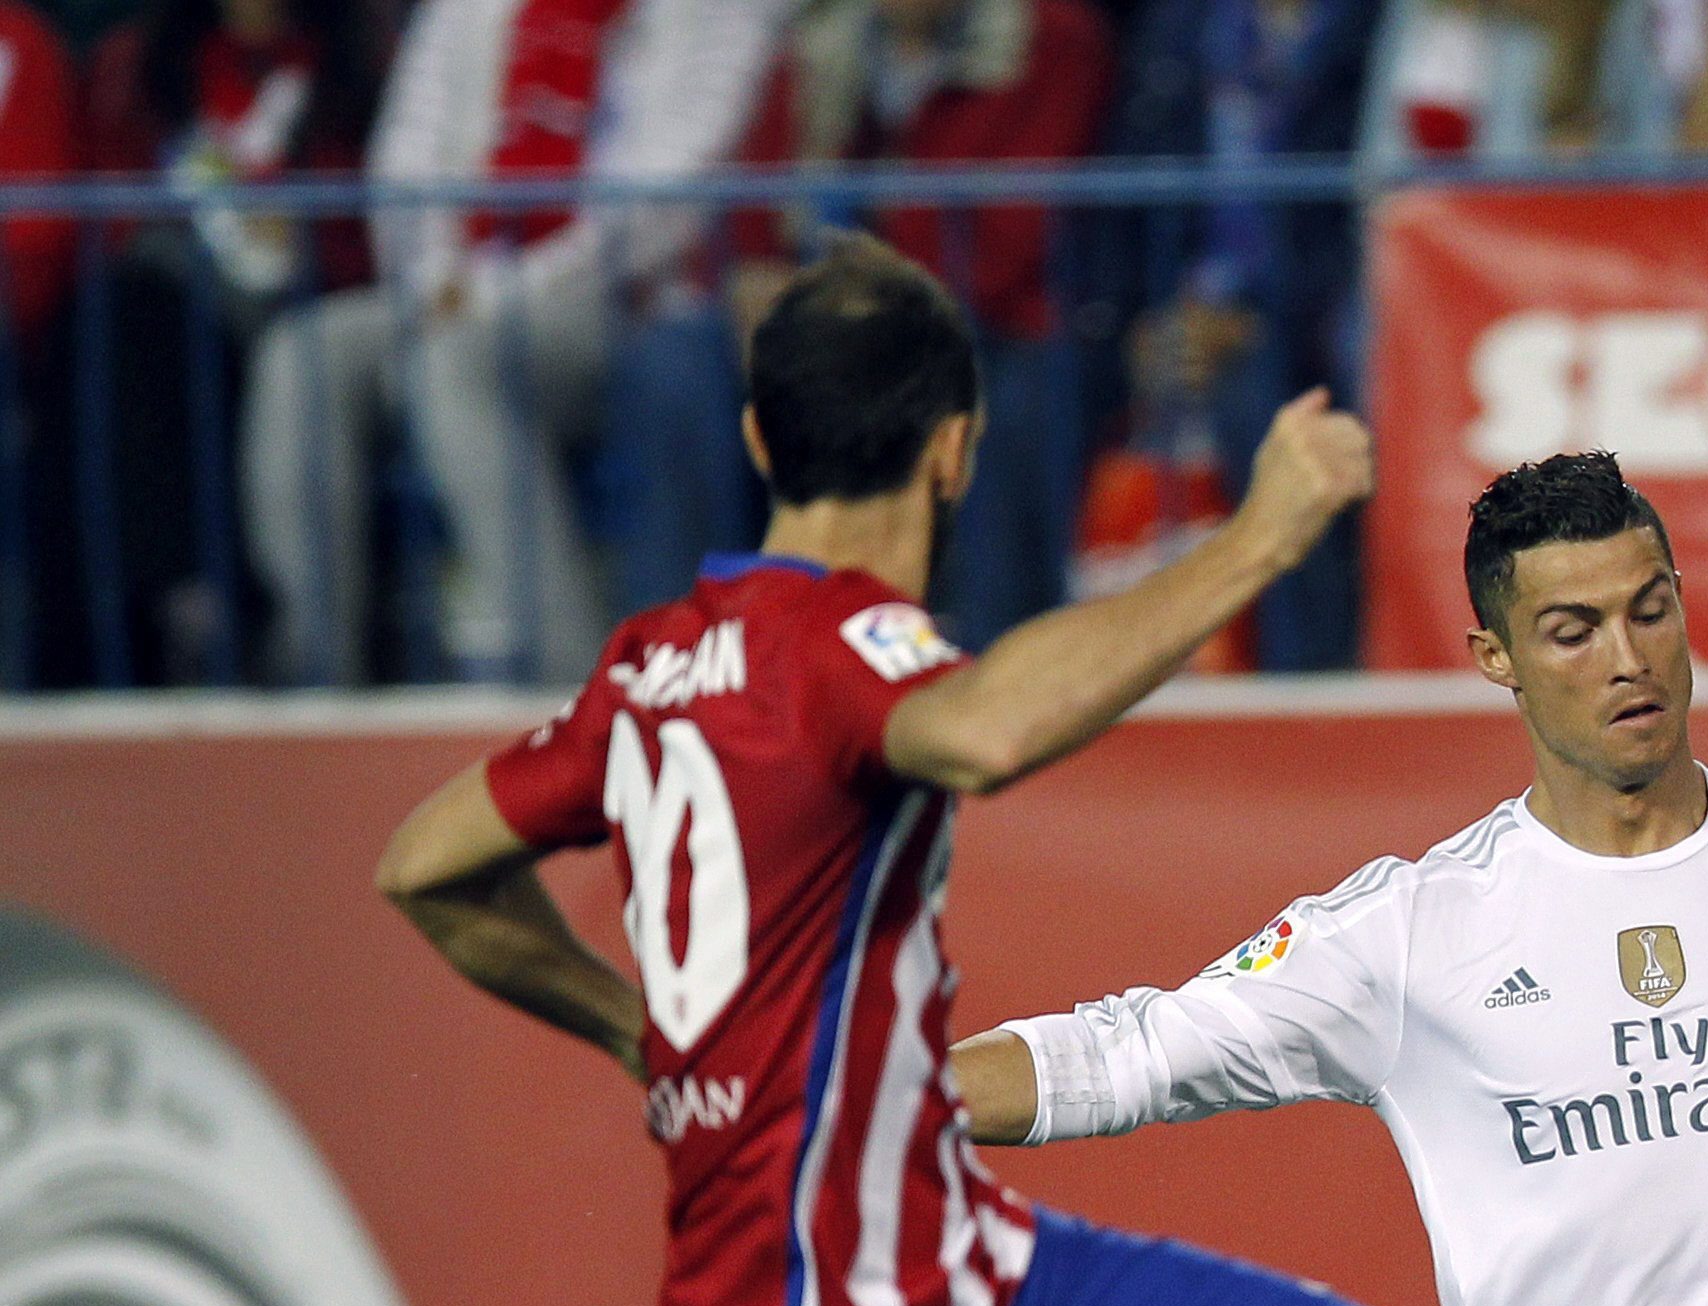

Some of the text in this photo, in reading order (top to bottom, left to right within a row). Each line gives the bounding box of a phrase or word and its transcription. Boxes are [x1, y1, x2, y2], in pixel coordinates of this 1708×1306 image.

[1639, 976, 1671, 991] FIFA
[1484, 988, 1551, 1009] adidas
[1611, 1017, 1708, 1066] Fly
